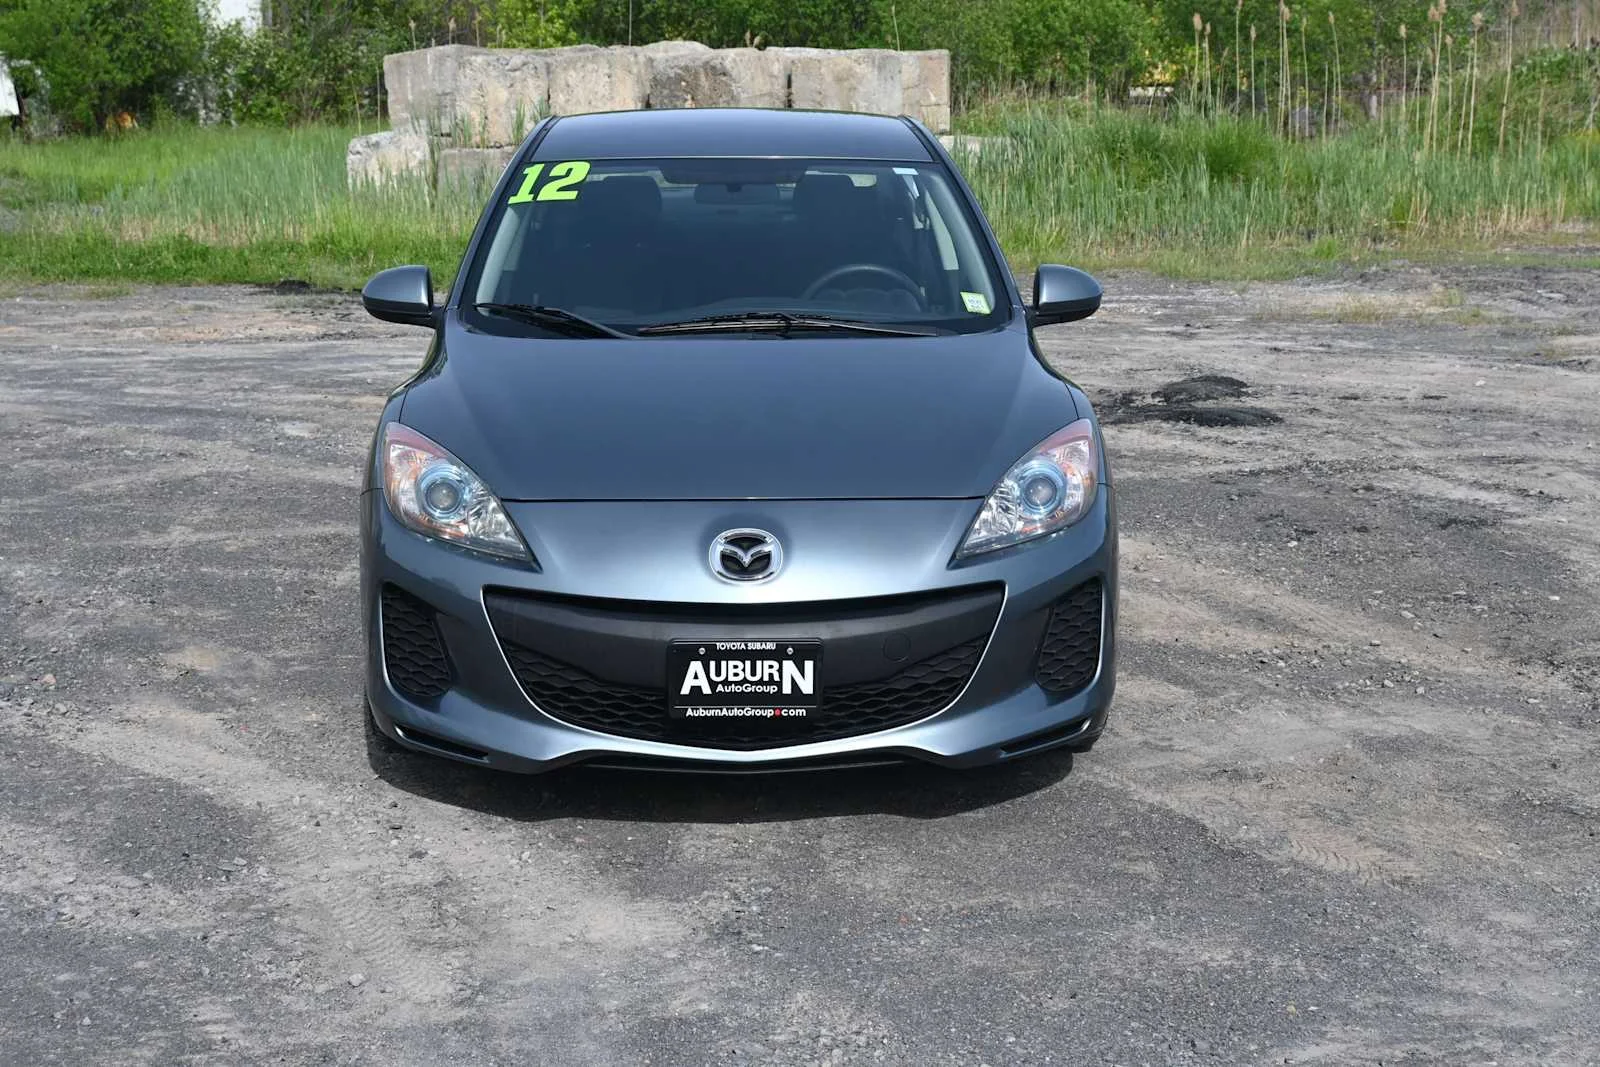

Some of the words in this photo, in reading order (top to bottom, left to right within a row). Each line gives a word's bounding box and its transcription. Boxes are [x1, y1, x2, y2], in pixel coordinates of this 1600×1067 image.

[508, 161, 591, 205] 12
[680, 660, 814, 695] AUBURN
[715, 683, 778, 694] AutoGroup
[686, 708, 806, 718] AuburnAutoGroup.com
